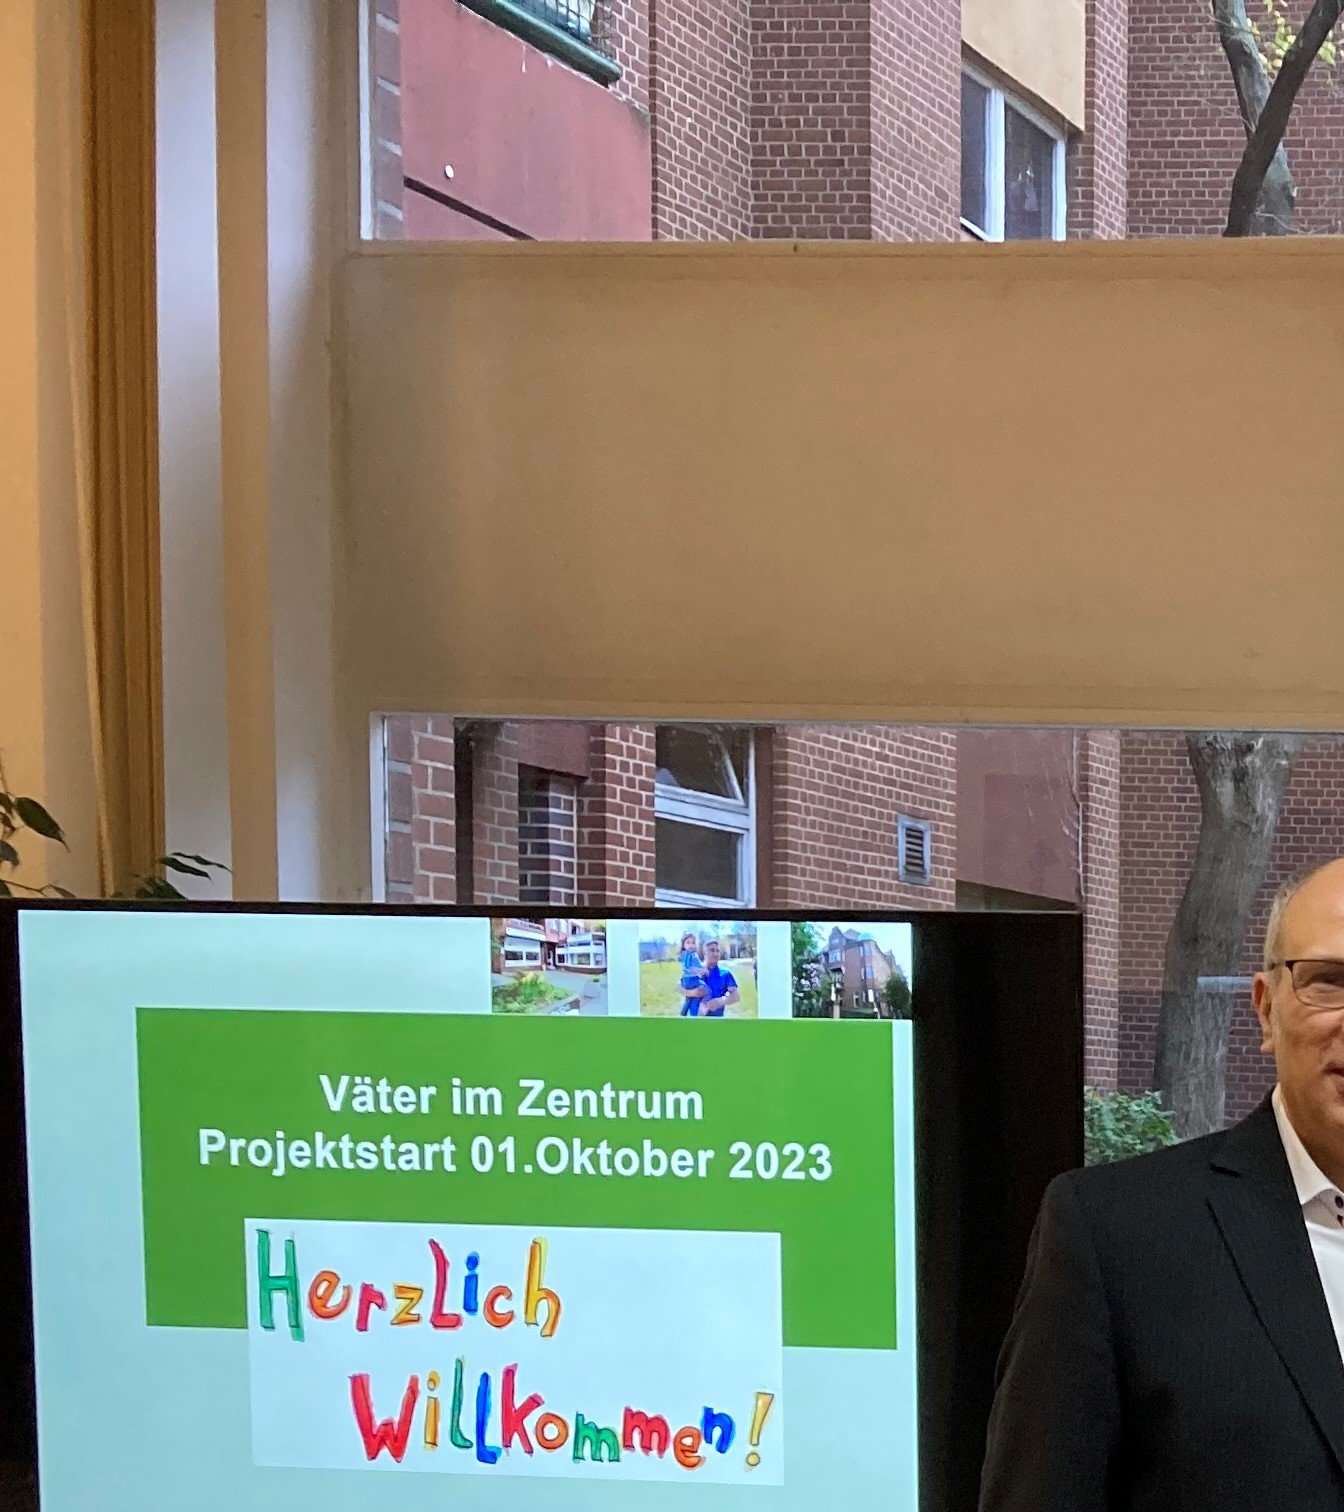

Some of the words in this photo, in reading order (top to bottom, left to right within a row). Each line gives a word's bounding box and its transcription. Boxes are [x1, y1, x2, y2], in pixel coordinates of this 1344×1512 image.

[319, 1074, 437, 1115] Väter
[451, 1076, 503, 1116] im
[517, 1078, 704, 1120] Zentrum
[198, 1128, 457, 1177] Projektstart
[470, 1135, 716, 1178] 01.Oktober
[729, 1142, 833, 1181] 2023
